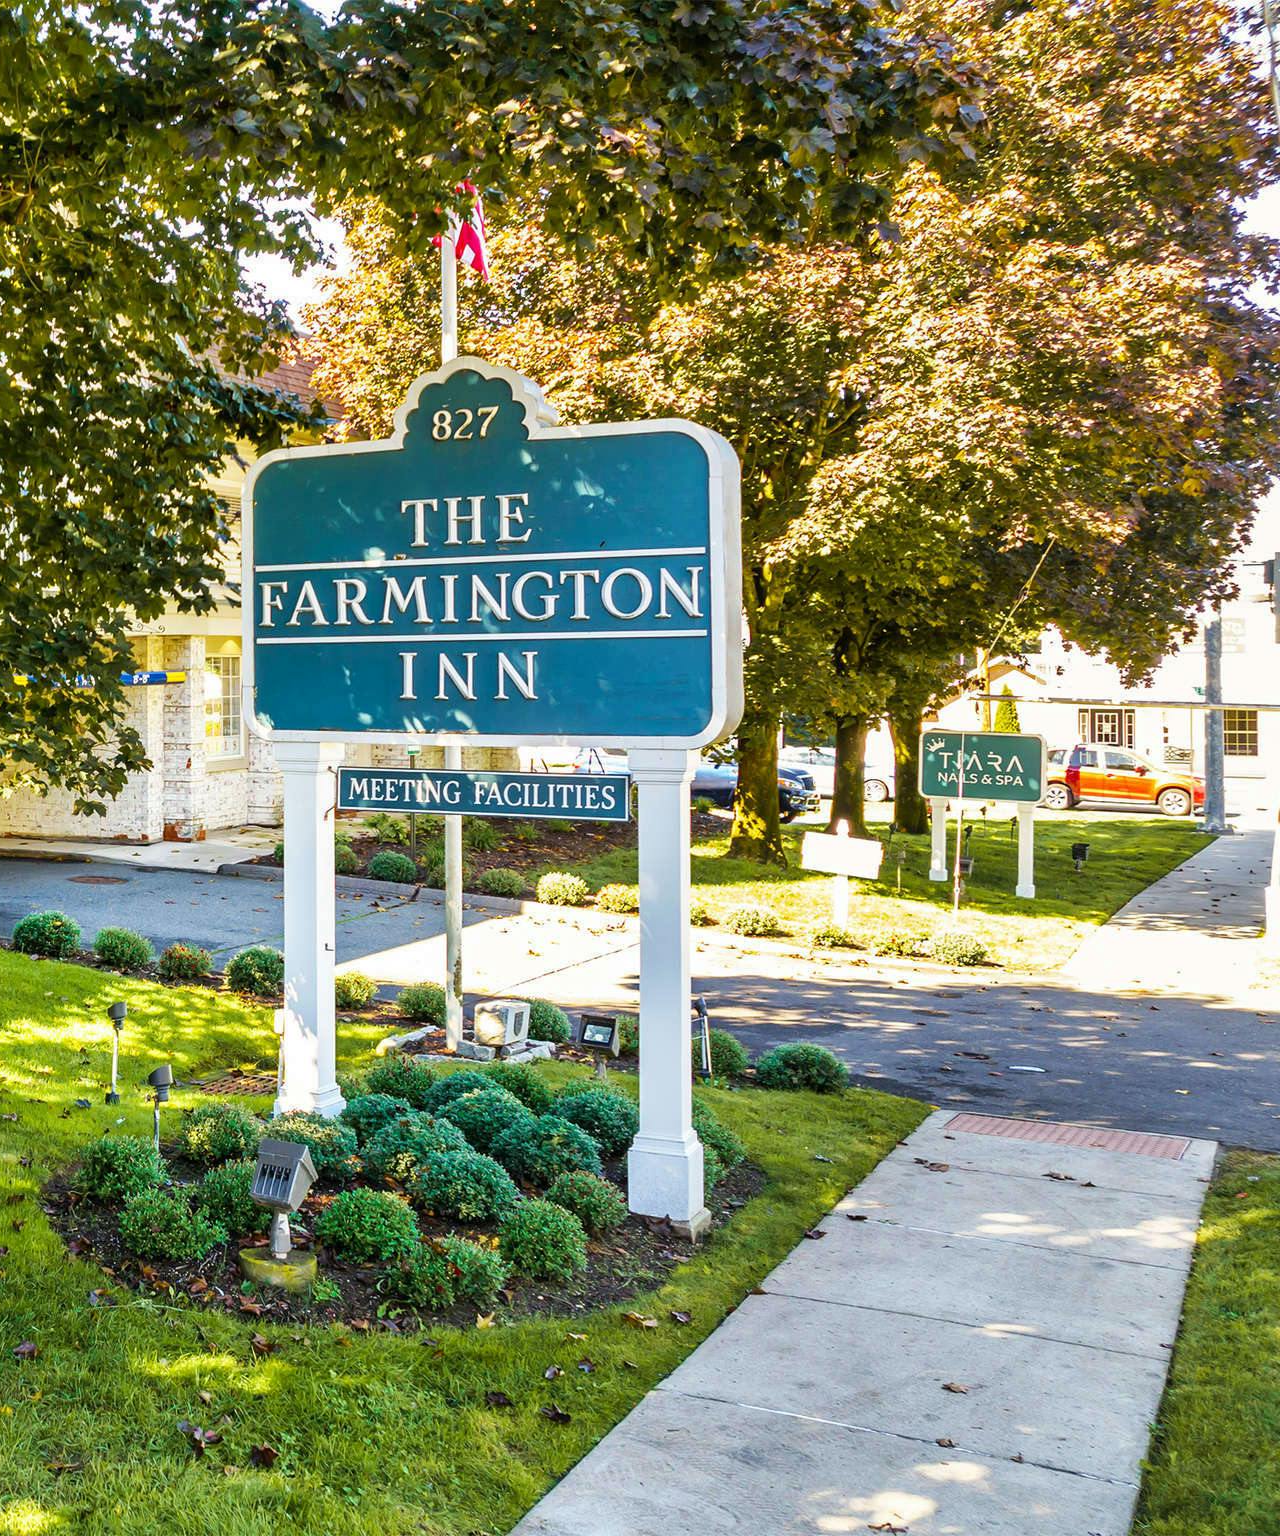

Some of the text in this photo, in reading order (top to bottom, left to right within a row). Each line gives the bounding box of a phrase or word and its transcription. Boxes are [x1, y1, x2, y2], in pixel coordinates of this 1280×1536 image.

[431, 405, 500, 441] 827
[400, 493, 533, 547] THE
[259, 566, 704, 628] FARMINGTON
[399, 651, 539, 702] INN
[937, 772, 1024, 786] NALS & SPA
[938, 750, 1024, 773] TIARA
[348, 777, 615, 810] MEETING FACILITIES
